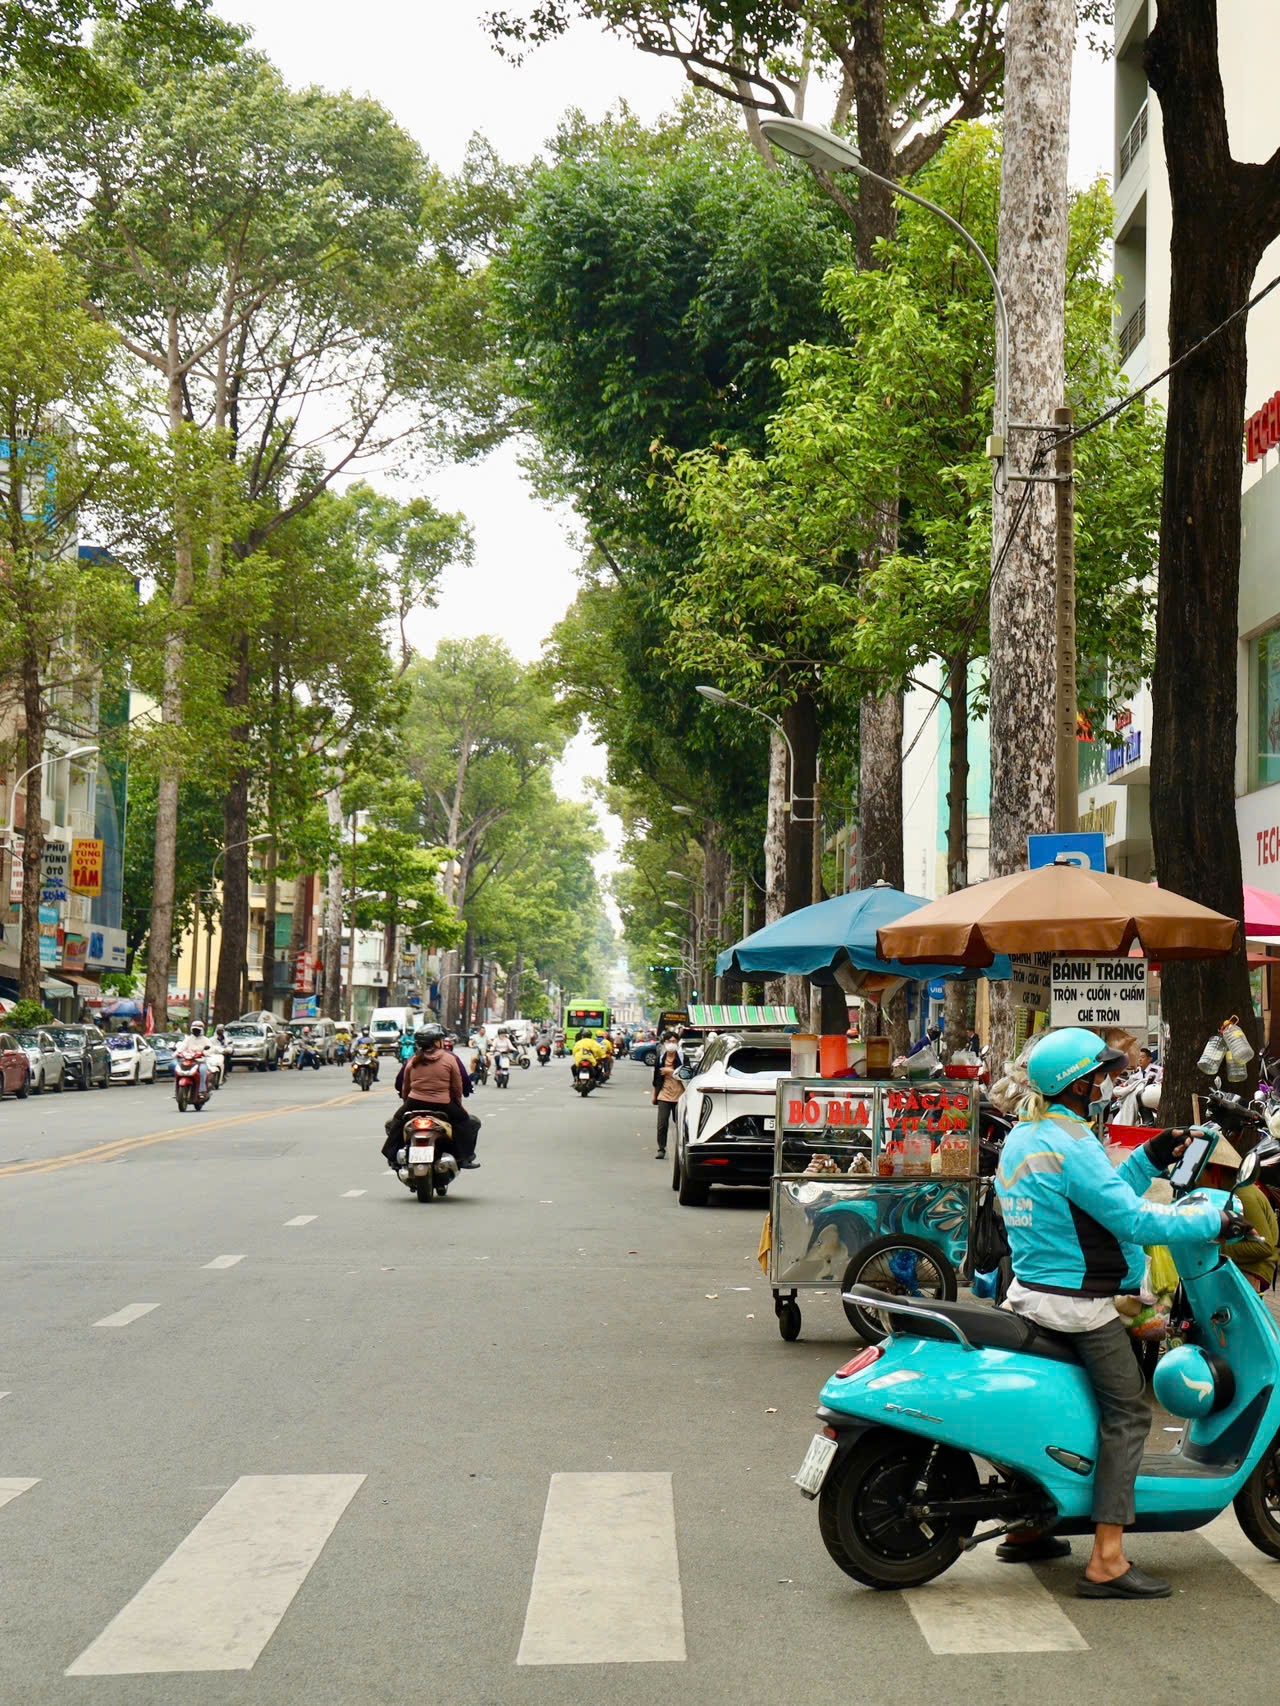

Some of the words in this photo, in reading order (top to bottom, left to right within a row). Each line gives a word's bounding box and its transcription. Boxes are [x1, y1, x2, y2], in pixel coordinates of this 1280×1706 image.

[73, 866, 99, 887] TÂM
[1096, 959, 1144, 980] TRÁNG
[1053, 985, 1077, 1004] TRỘN
[1087, 984, 1110, 1001] CUỐN
[1096, 1007, 1120, 1024] TRỘN
